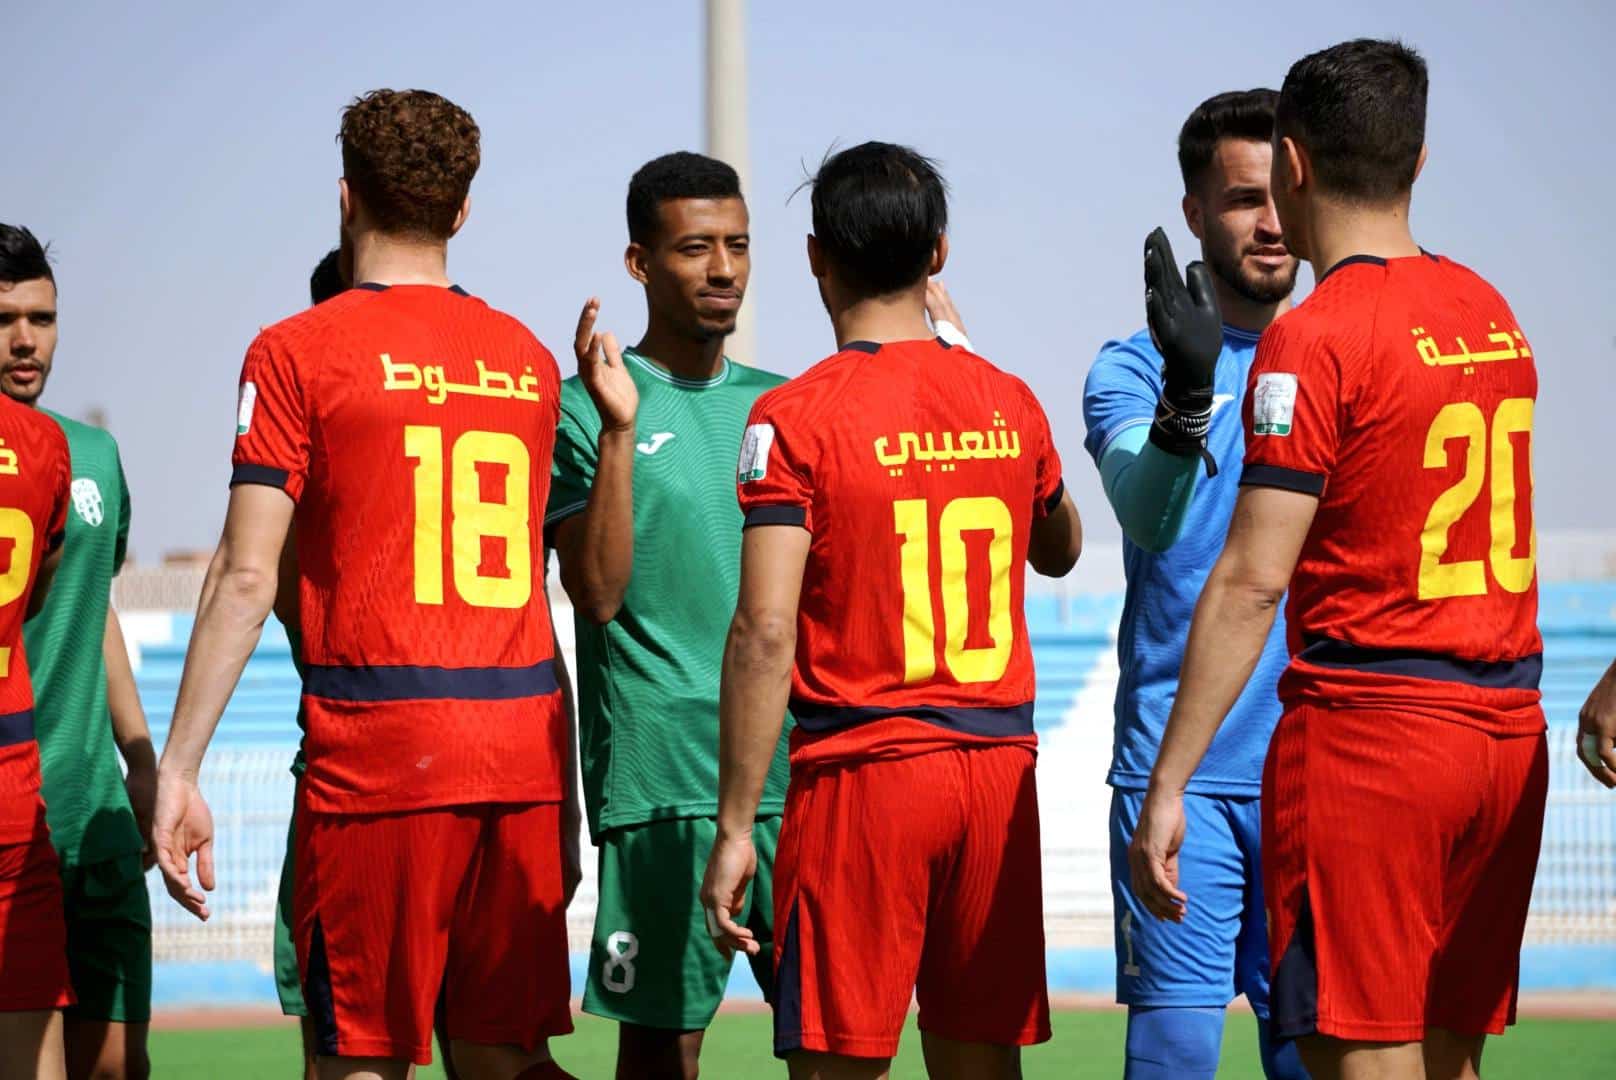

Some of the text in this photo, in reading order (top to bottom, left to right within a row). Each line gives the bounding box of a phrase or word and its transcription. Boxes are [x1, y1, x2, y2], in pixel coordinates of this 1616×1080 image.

[380, 353, 541, 405] غطوط
[874, 410, 1021, 476] شعيبي
[404, 424, 532, 608] 18
[1418, 397, 1536, 600] 20
[893, 496, 1014, 684] 10
[602, 930, 639, 993] 8
[1121, 910, 1140, 977] 1
